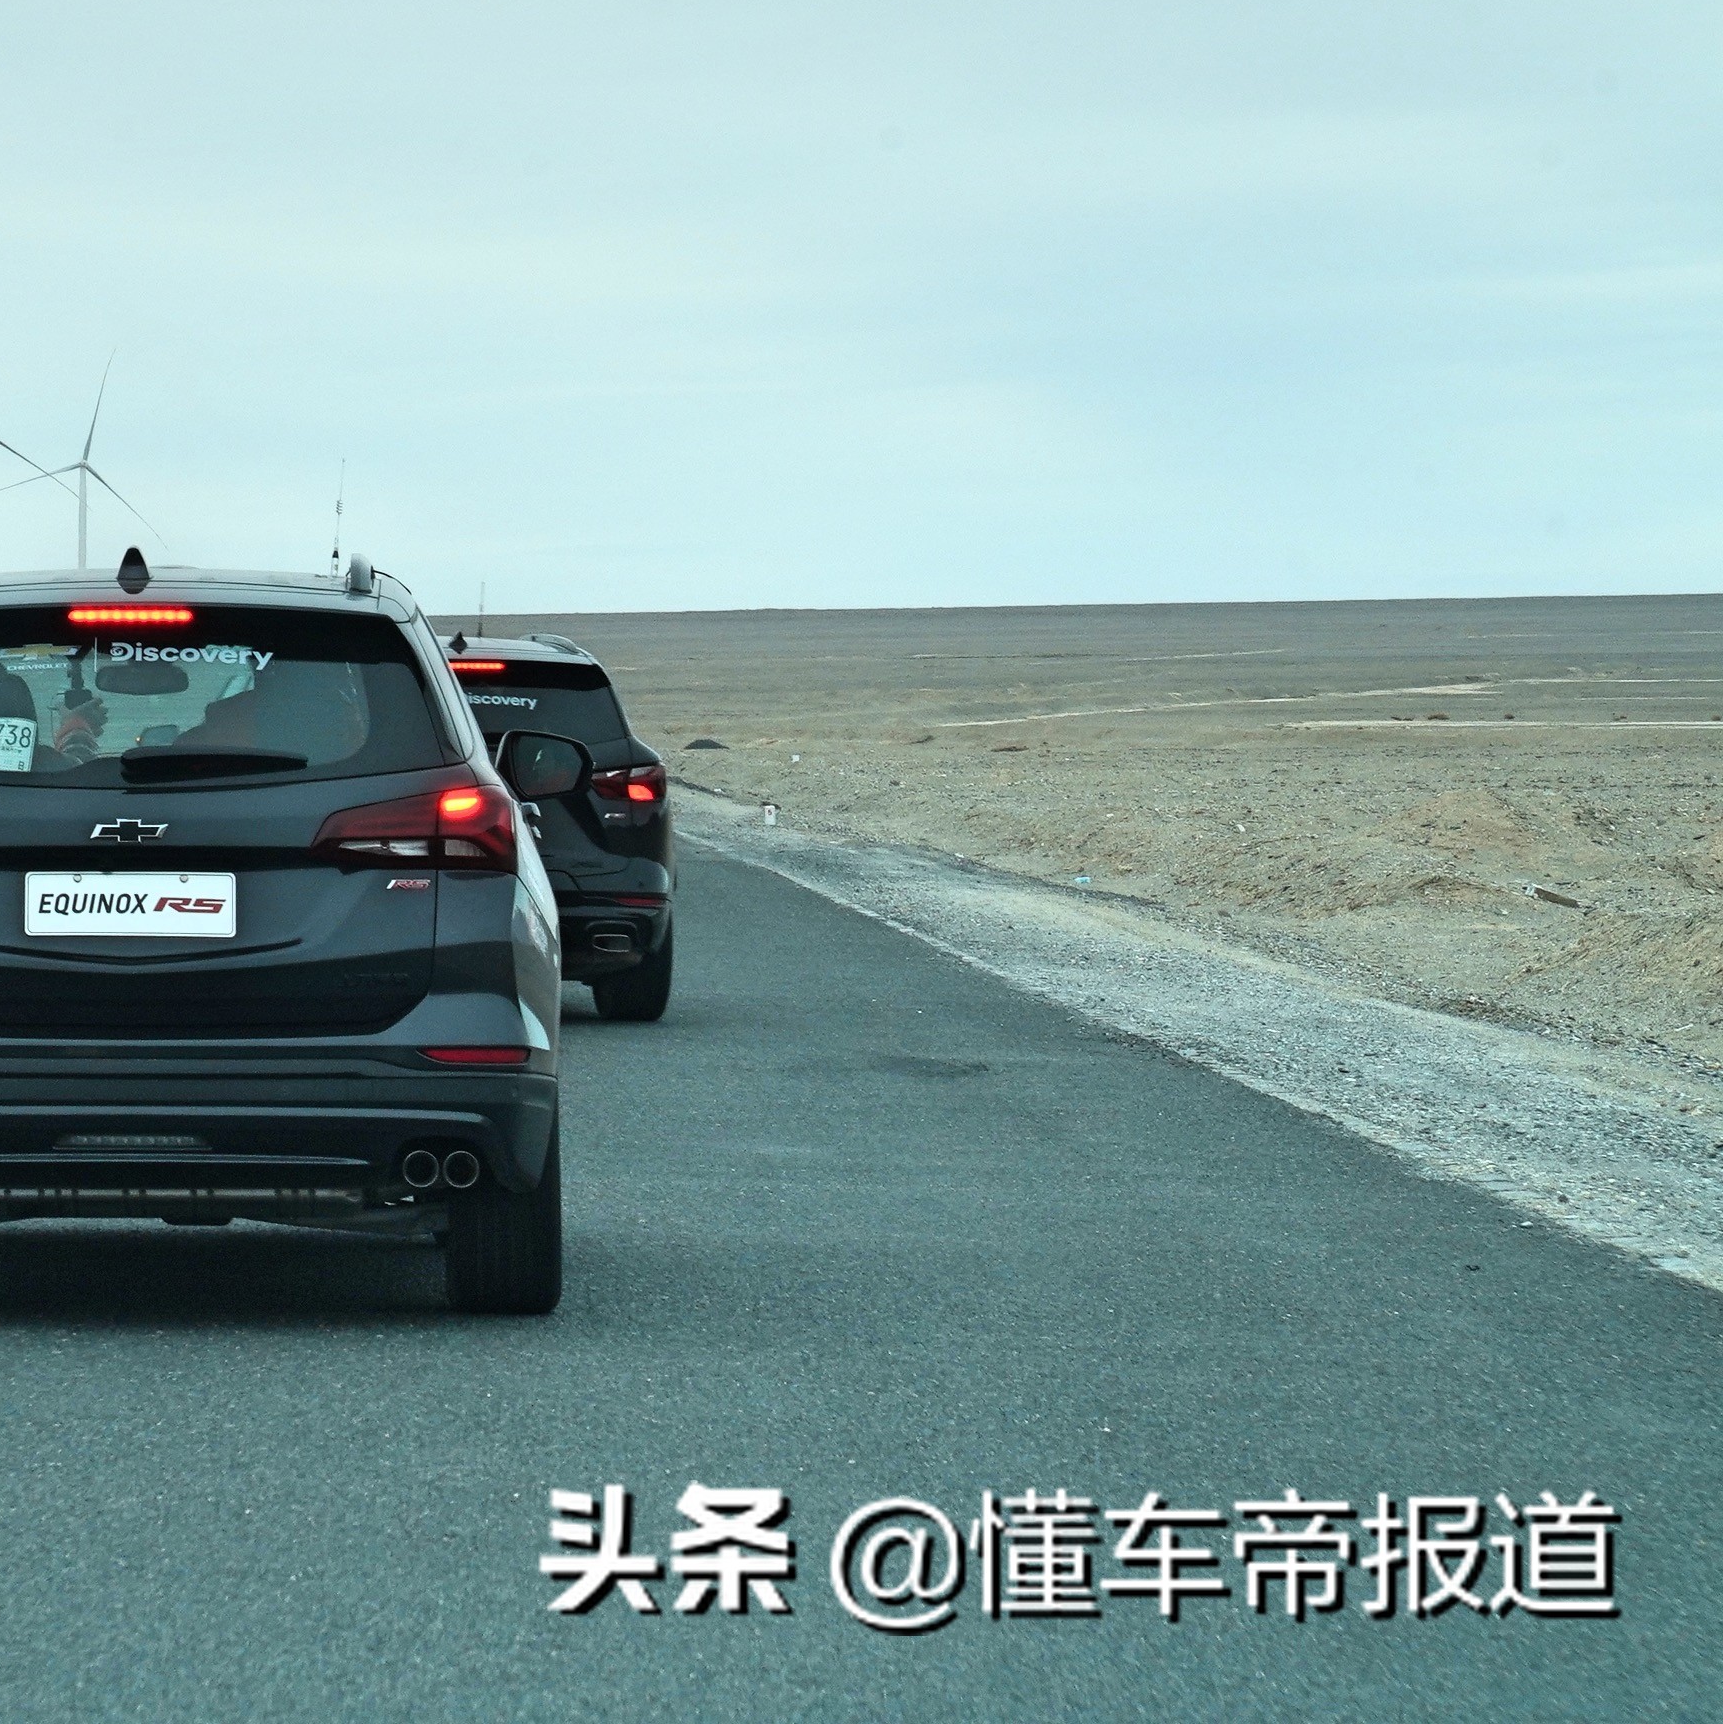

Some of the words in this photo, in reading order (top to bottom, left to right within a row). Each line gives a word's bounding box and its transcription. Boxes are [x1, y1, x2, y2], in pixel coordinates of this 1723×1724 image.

[110, 642, 274, 670] Discovery
[7, 662, 69, 671] CHEVROLET
[466, 692, 538, 710] iscovery
[386, 879, 431, 891] RS
[39, 893, 148, 915] EQUINOX
[153, 897, 226, 914] RS
